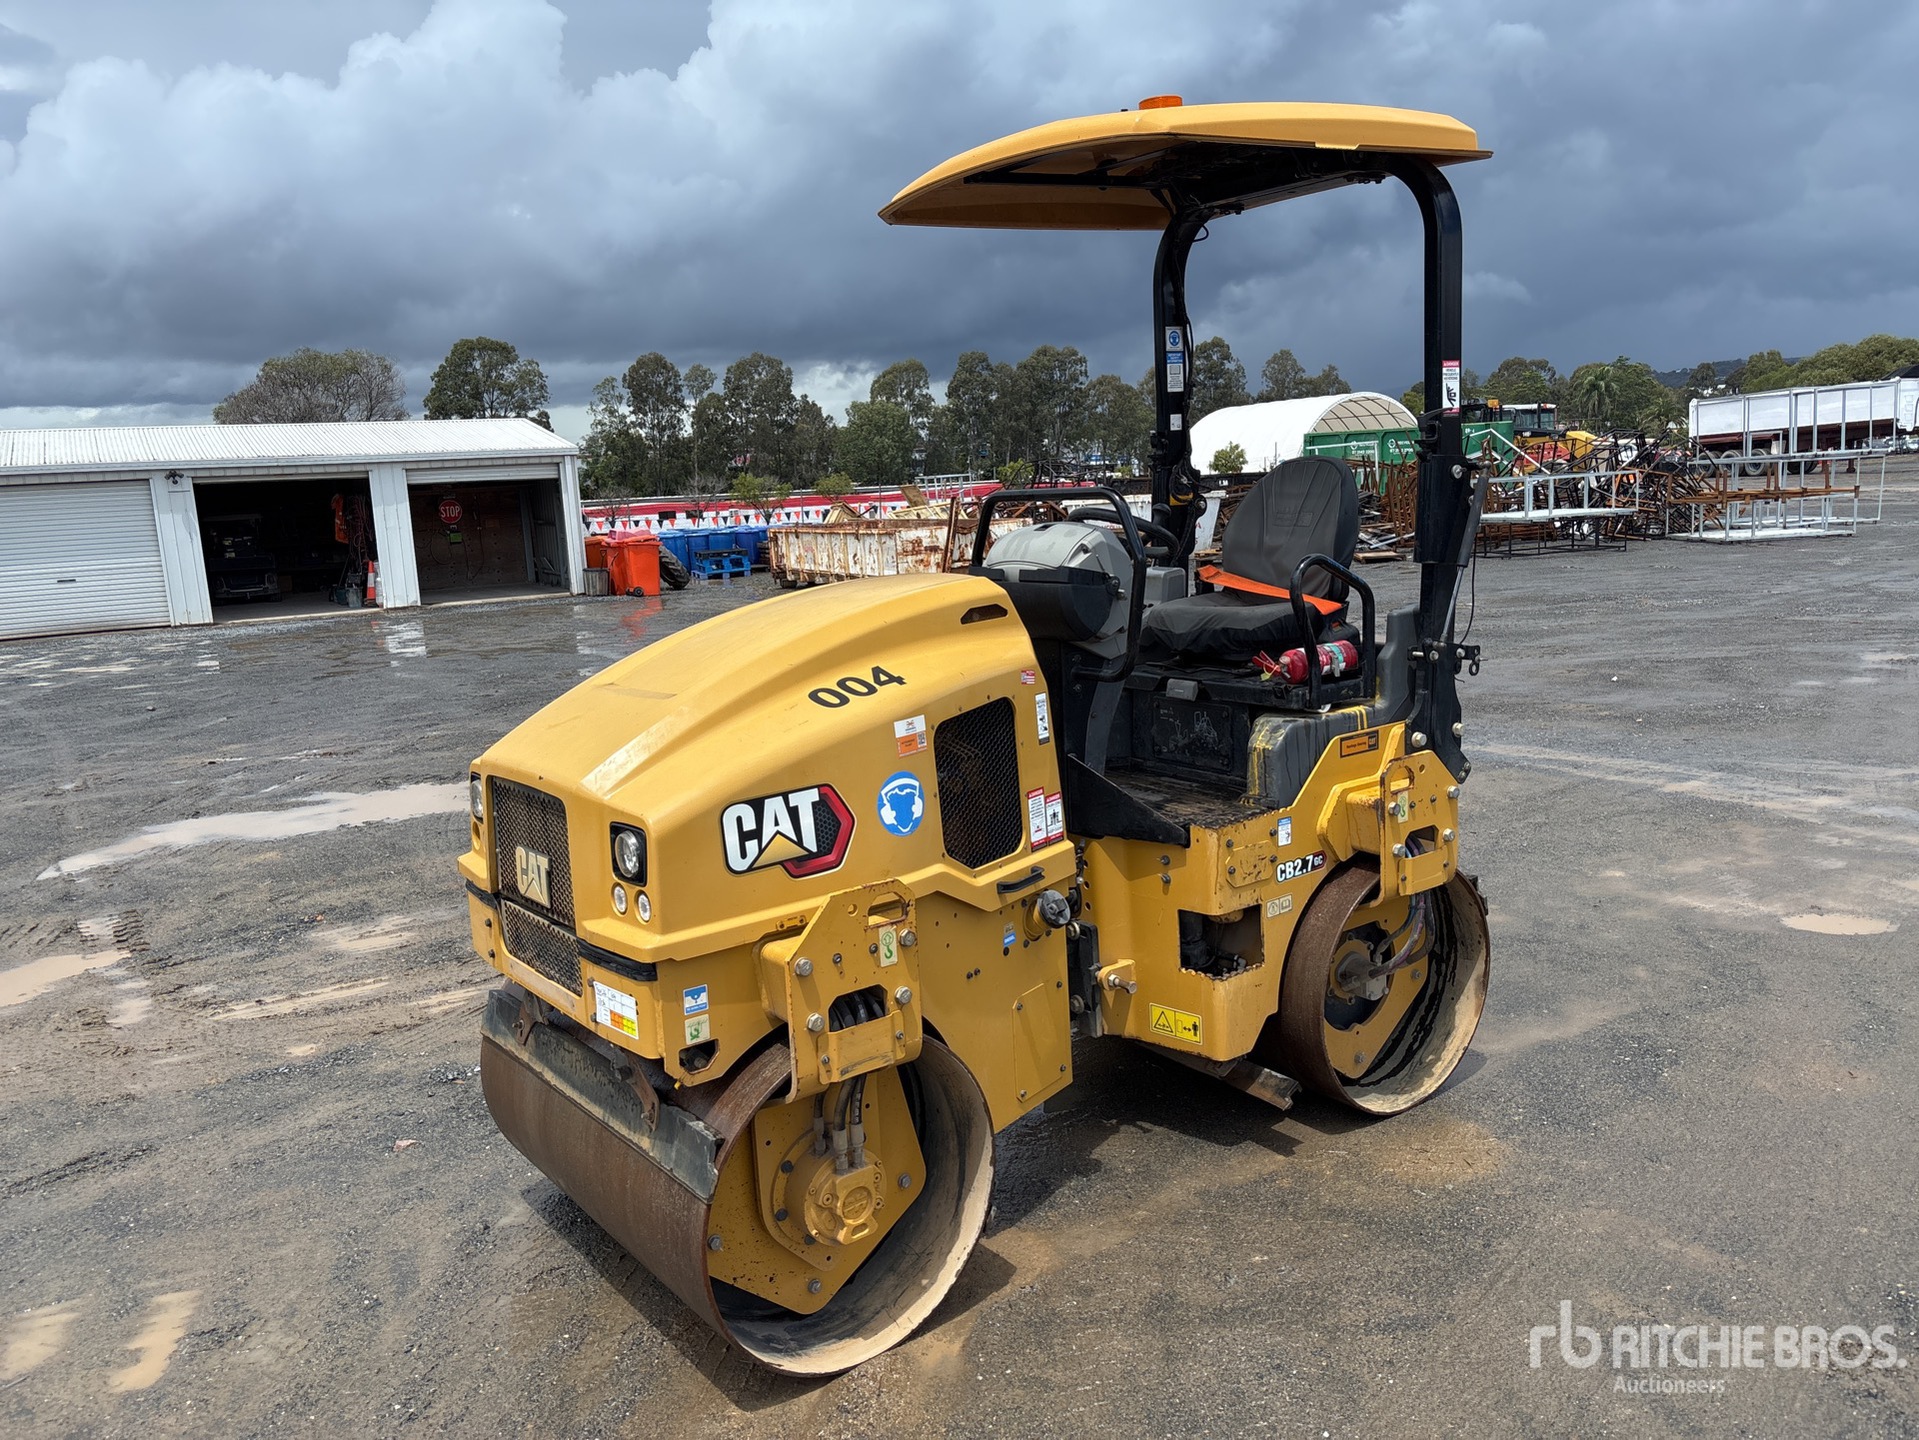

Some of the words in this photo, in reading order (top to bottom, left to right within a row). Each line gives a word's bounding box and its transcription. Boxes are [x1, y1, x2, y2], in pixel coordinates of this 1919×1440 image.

[440, 506, 460, 518] STOP
[808, 665, 907, 709] 004
[722, 787, 820, 872] CAT
[515, 845, 551, 909] CAT
[1276, 854, 1314, 883] CB2.7
[1313, 855, 1323, 867] GC
